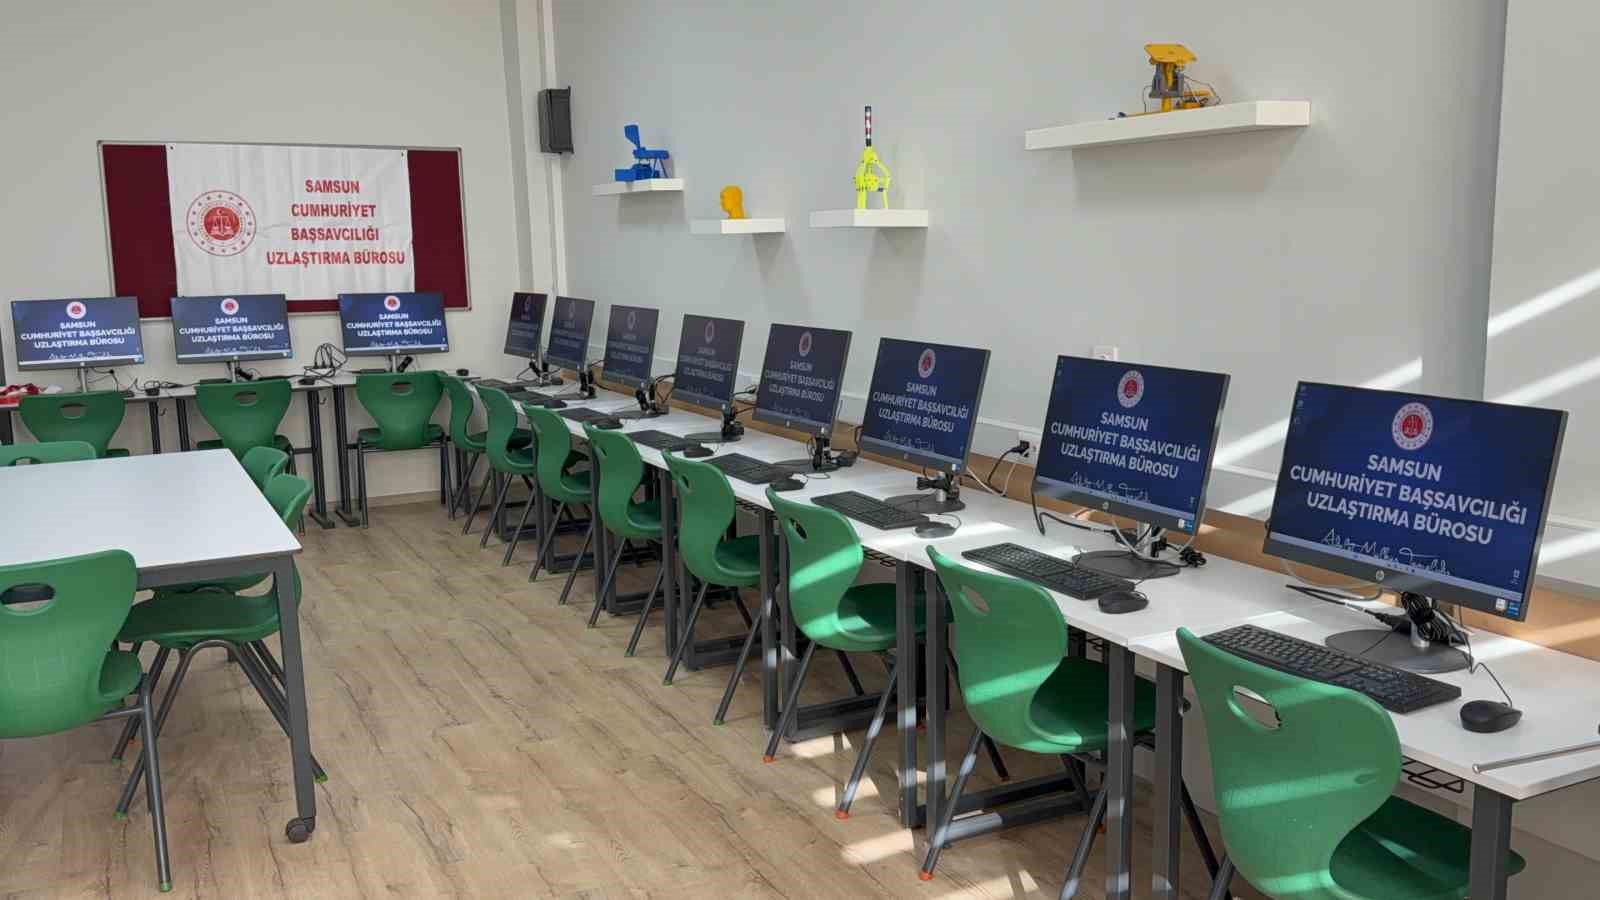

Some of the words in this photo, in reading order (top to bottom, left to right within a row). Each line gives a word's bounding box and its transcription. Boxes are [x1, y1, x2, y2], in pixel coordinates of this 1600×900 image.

[305, 179, 360, 193] SAMSUN
[291, 201, 376, 217] CUMHURİYET
[291, 225, 379, 243] BAŞSAVCILIĞI
[266, 251, 350, 267] UZLAŞTIRMA
[354, 248, 405, 264] BÜROSU
[60, 321, 96, 329] SAMSUN
[21, 330, 77, 340] CUMHURİYET
[34, 340, 88, 349] UZLAŞTIRMA
[90, 337, 125, 345] BÜROSU
[242, 332, 275, 340] BÜROSU
[906, 382, 937, 397] SAMSUN
[873, 391, 917, 409] CUMHURİYET
[917, 399, 969, 419] BAŞSAVCILIĞI
[878, 407, 921, 424] UZLAŞTIRMA
[922, 415, 954, 432] BÜROSU
[1100, 412, 1149, 431] SAMSUN
[1051, 422, 1120, 446] CUMHURİYET
[1120, 434, 1200, 463] BAŞSAVCILIĞI
[1061, 442, 1126, 466] UZLAŞTIRMA
[1128, 455, 1178, 479] BÜROSU
[1367, 454, 1443, 482] SAMSUN
[1290, 465, 1397, 499] CUMHURİYET
[1398, 486, 1527, 525] BAŞSAVCILIĞI
[1306, 491, 1409, 529] UZLAŞTIRMA
[1413, 512, 1493, 545] BÜROSU
